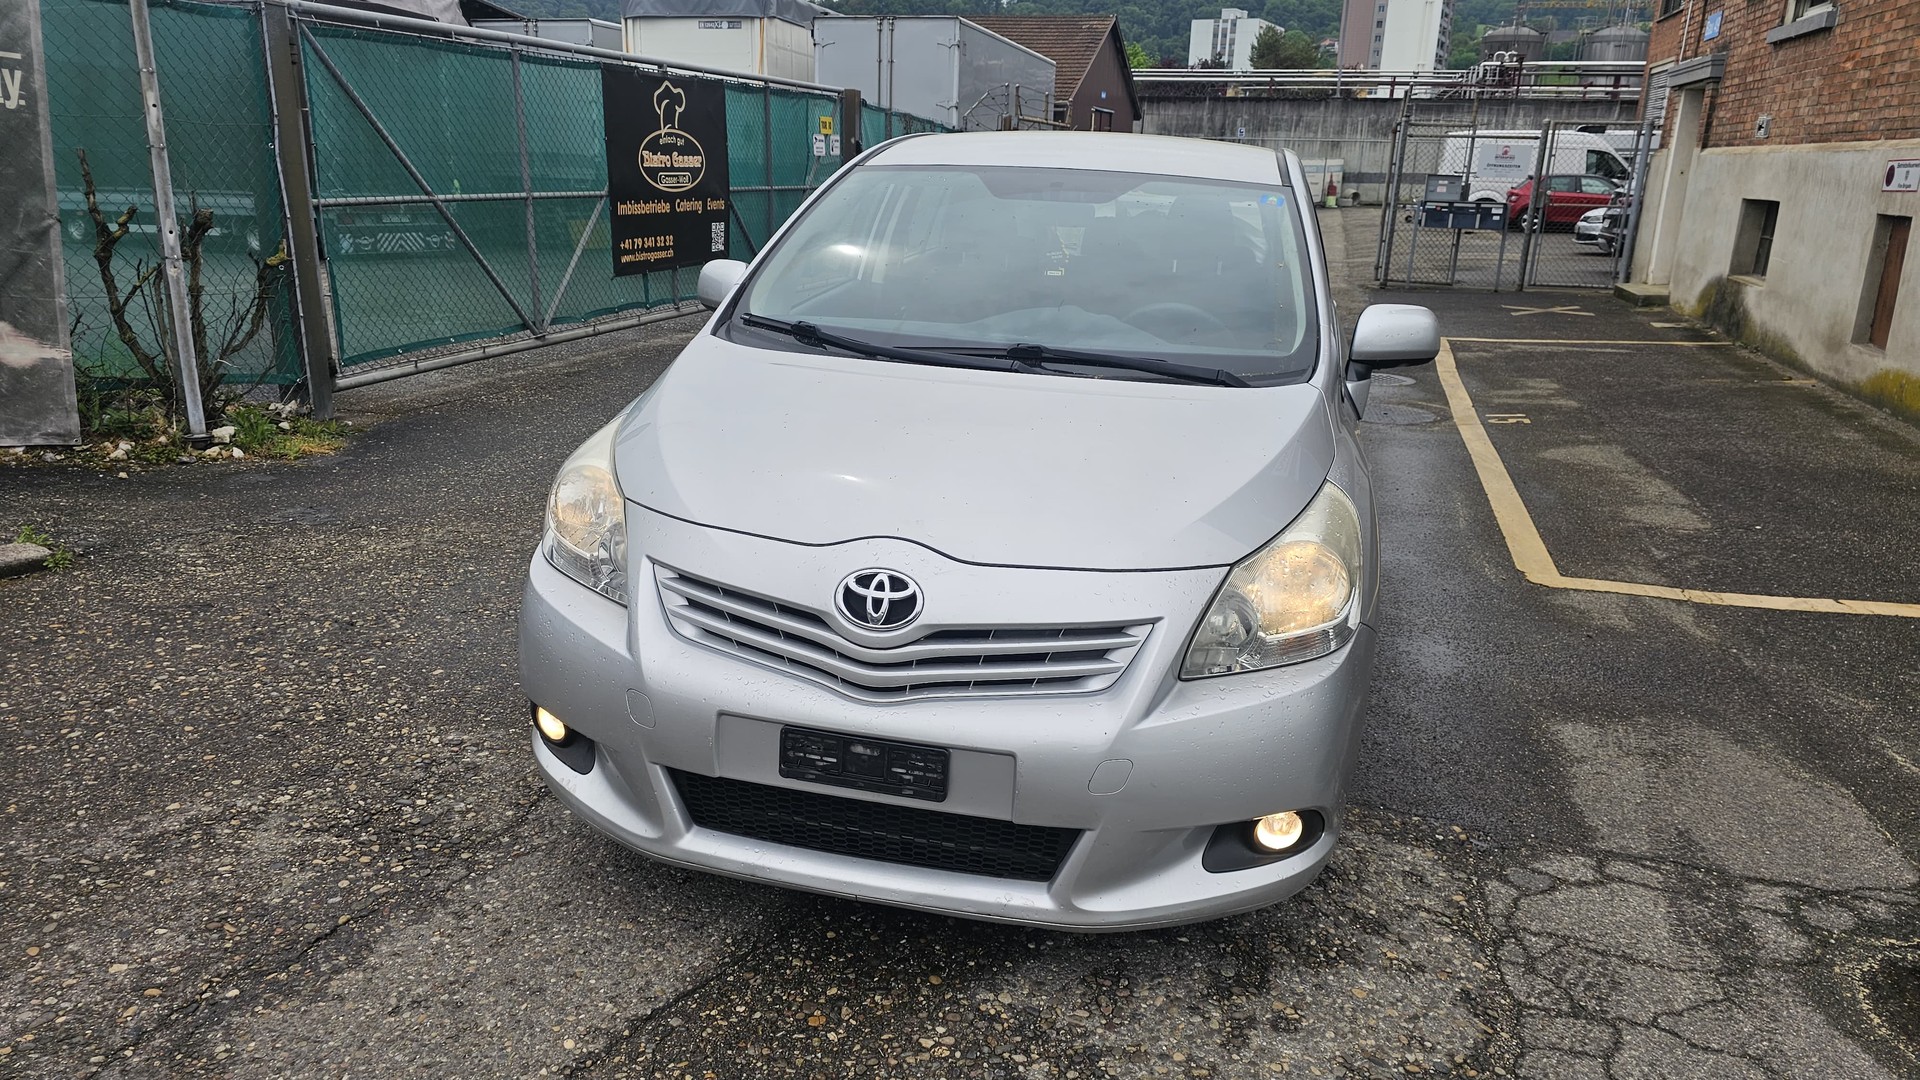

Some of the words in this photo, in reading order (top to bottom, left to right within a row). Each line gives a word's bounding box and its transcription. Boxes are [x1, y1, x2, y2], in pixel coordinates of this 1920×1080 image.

[0, 68, 26, 109] y.
[659, 134, 676, 145] einfach
[677, 137, 685, 147] gut
[642, 150, 671, 167] Bistro
[672, 151, 703, 168] Gasser
[617, 199, 671, 215] Imbissbetriebe
[675, 198, 703, 214] Catering
[707, 198, 725, 210] Events
[620, 239, 632, 250] +41
[633, 238, 642, 249] 79
[644, 236, 655, 248] 341
[656, 236, 665, 247] 32
[665, 235, 674, 246] 32
[620, 248, 674, 263] www.bistrogasser.ch
